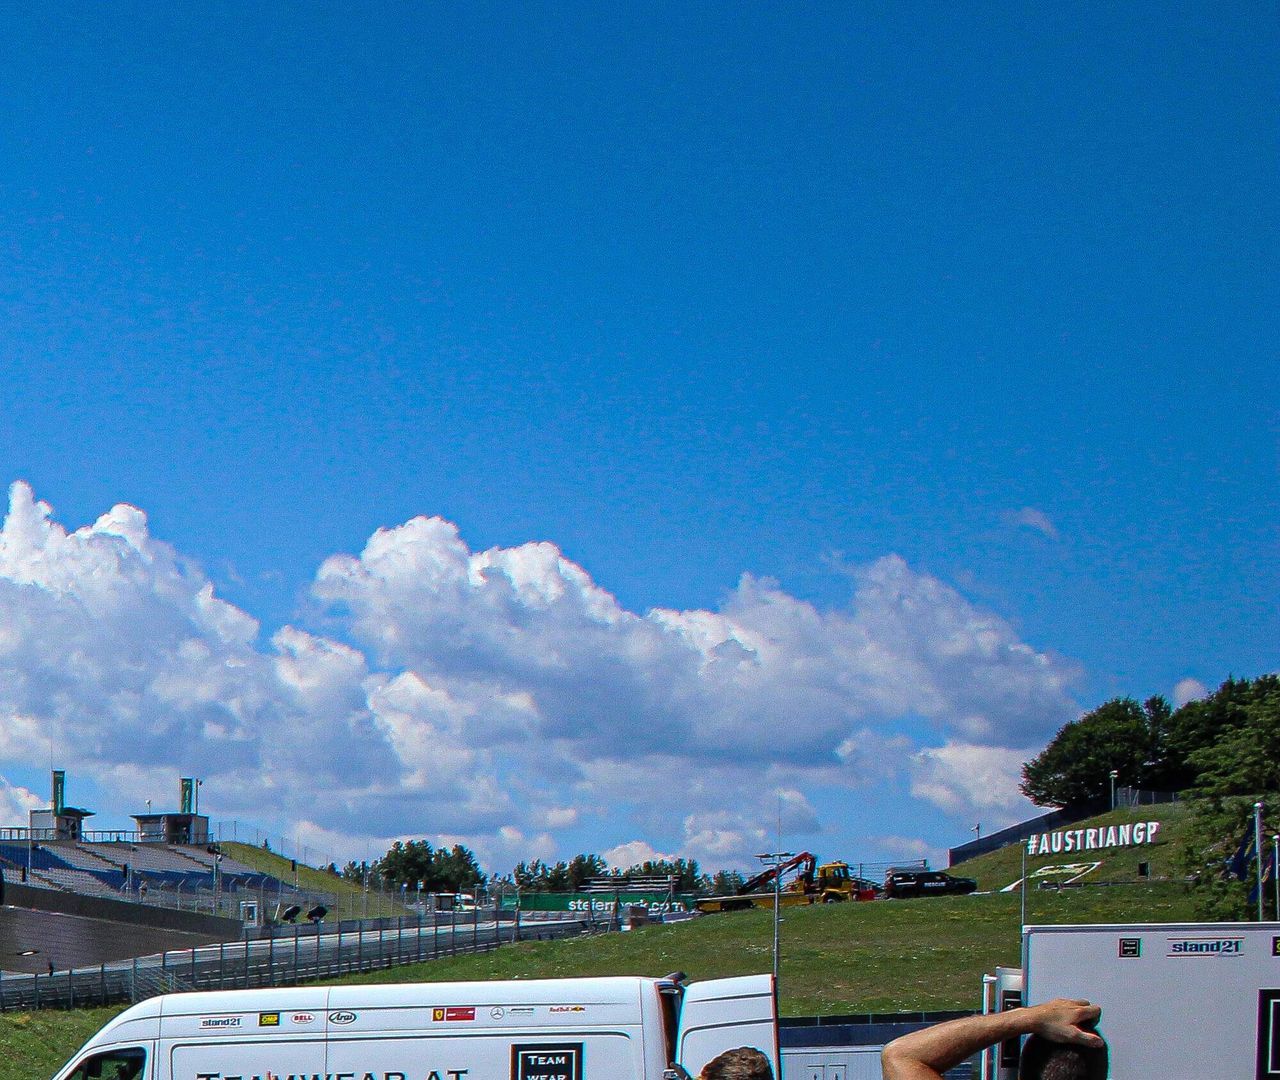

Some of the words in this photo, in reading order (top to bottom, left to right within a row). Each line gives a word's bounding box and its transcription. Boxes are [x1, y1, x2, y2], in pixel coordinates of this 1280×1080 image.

[1027, 821, 1160, 855] #AUSTRIANGP
[1172, 940, 1242, 953] stand21
[202, 1017, 241, 1027] stand21
[527, 1055, 566, 1065] TEAM
